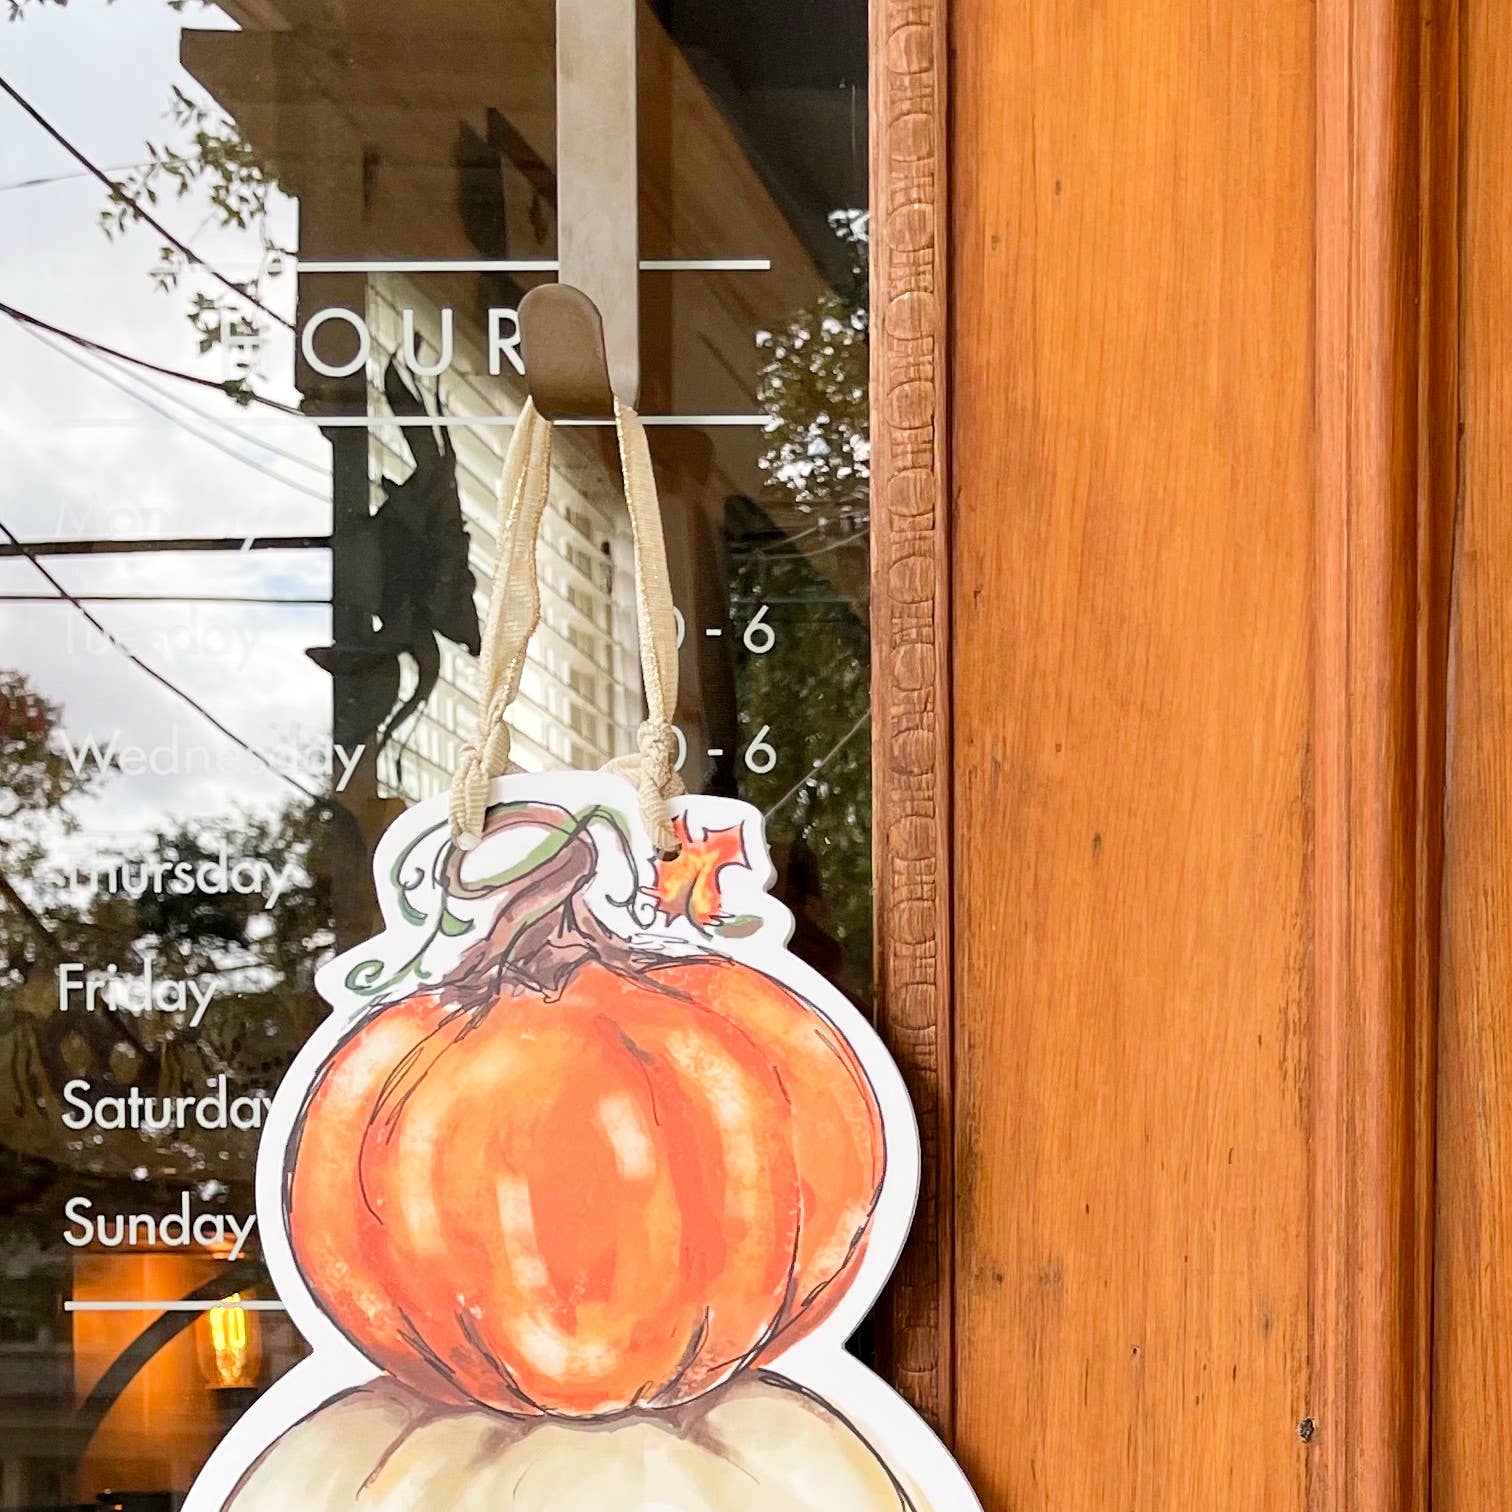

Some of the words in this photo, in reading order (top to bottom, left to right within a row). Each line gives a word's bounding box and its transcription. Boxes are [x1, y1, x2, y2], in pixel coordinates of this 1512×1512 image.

[743, 604, 776, 654] 6
[58, 722, 366, 792] Wedneday
[744, 724, 777, 774] 6
[58, 958, 218, 1027] Friday
[61, 1073, 274, 1130] Saturda
[62, 1191, 257, 1262] Sunday
